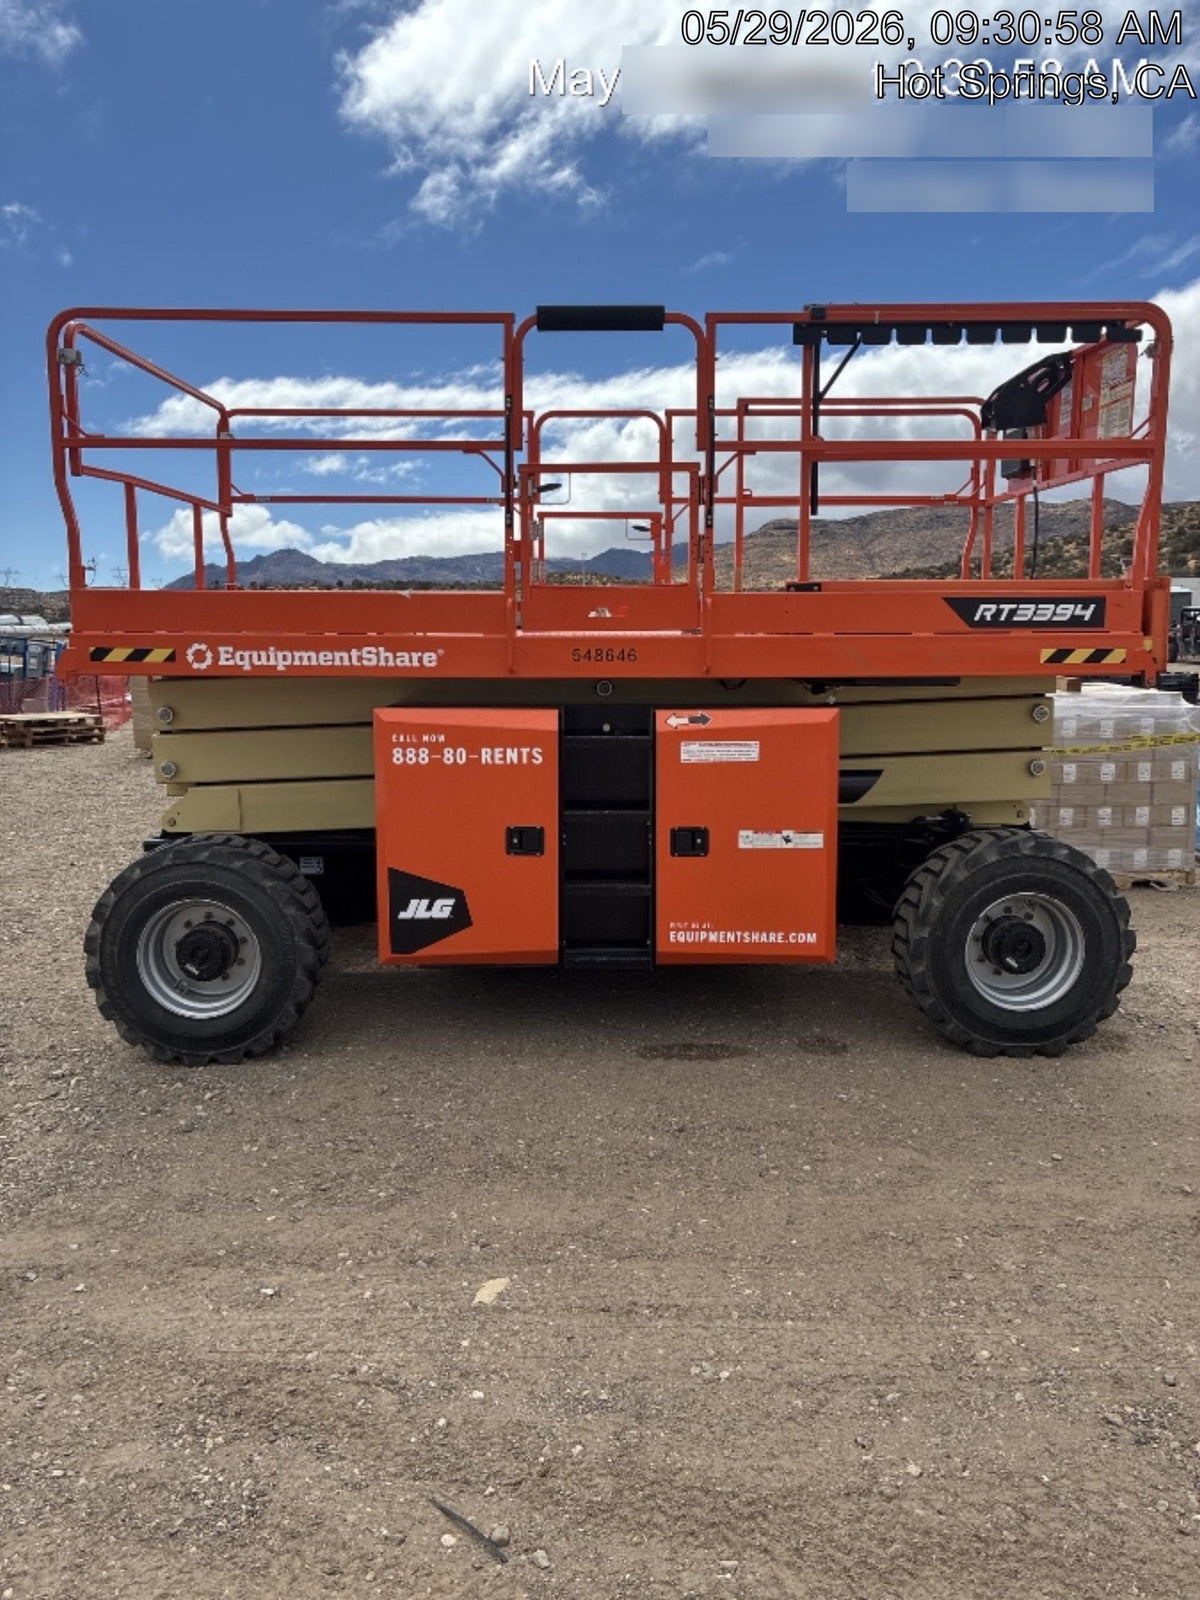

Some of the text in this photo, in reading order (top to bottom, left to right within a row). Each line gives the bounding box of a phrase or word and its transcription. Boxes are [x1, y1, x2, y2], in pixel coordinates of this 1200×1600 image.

[973, 603, 1096, 622] RT3394
[217, 645, 439, 670] EquipmentShare
[571, 647, 638, 663] 548646
[391, 733, 446, 743] CALL NOW
[391, 747, 544, 765] 888-80-RENTS
[397, 898, 456, 920] JLG
[669, 930, 818, 943] EQUIPMENTSHARE.COM
